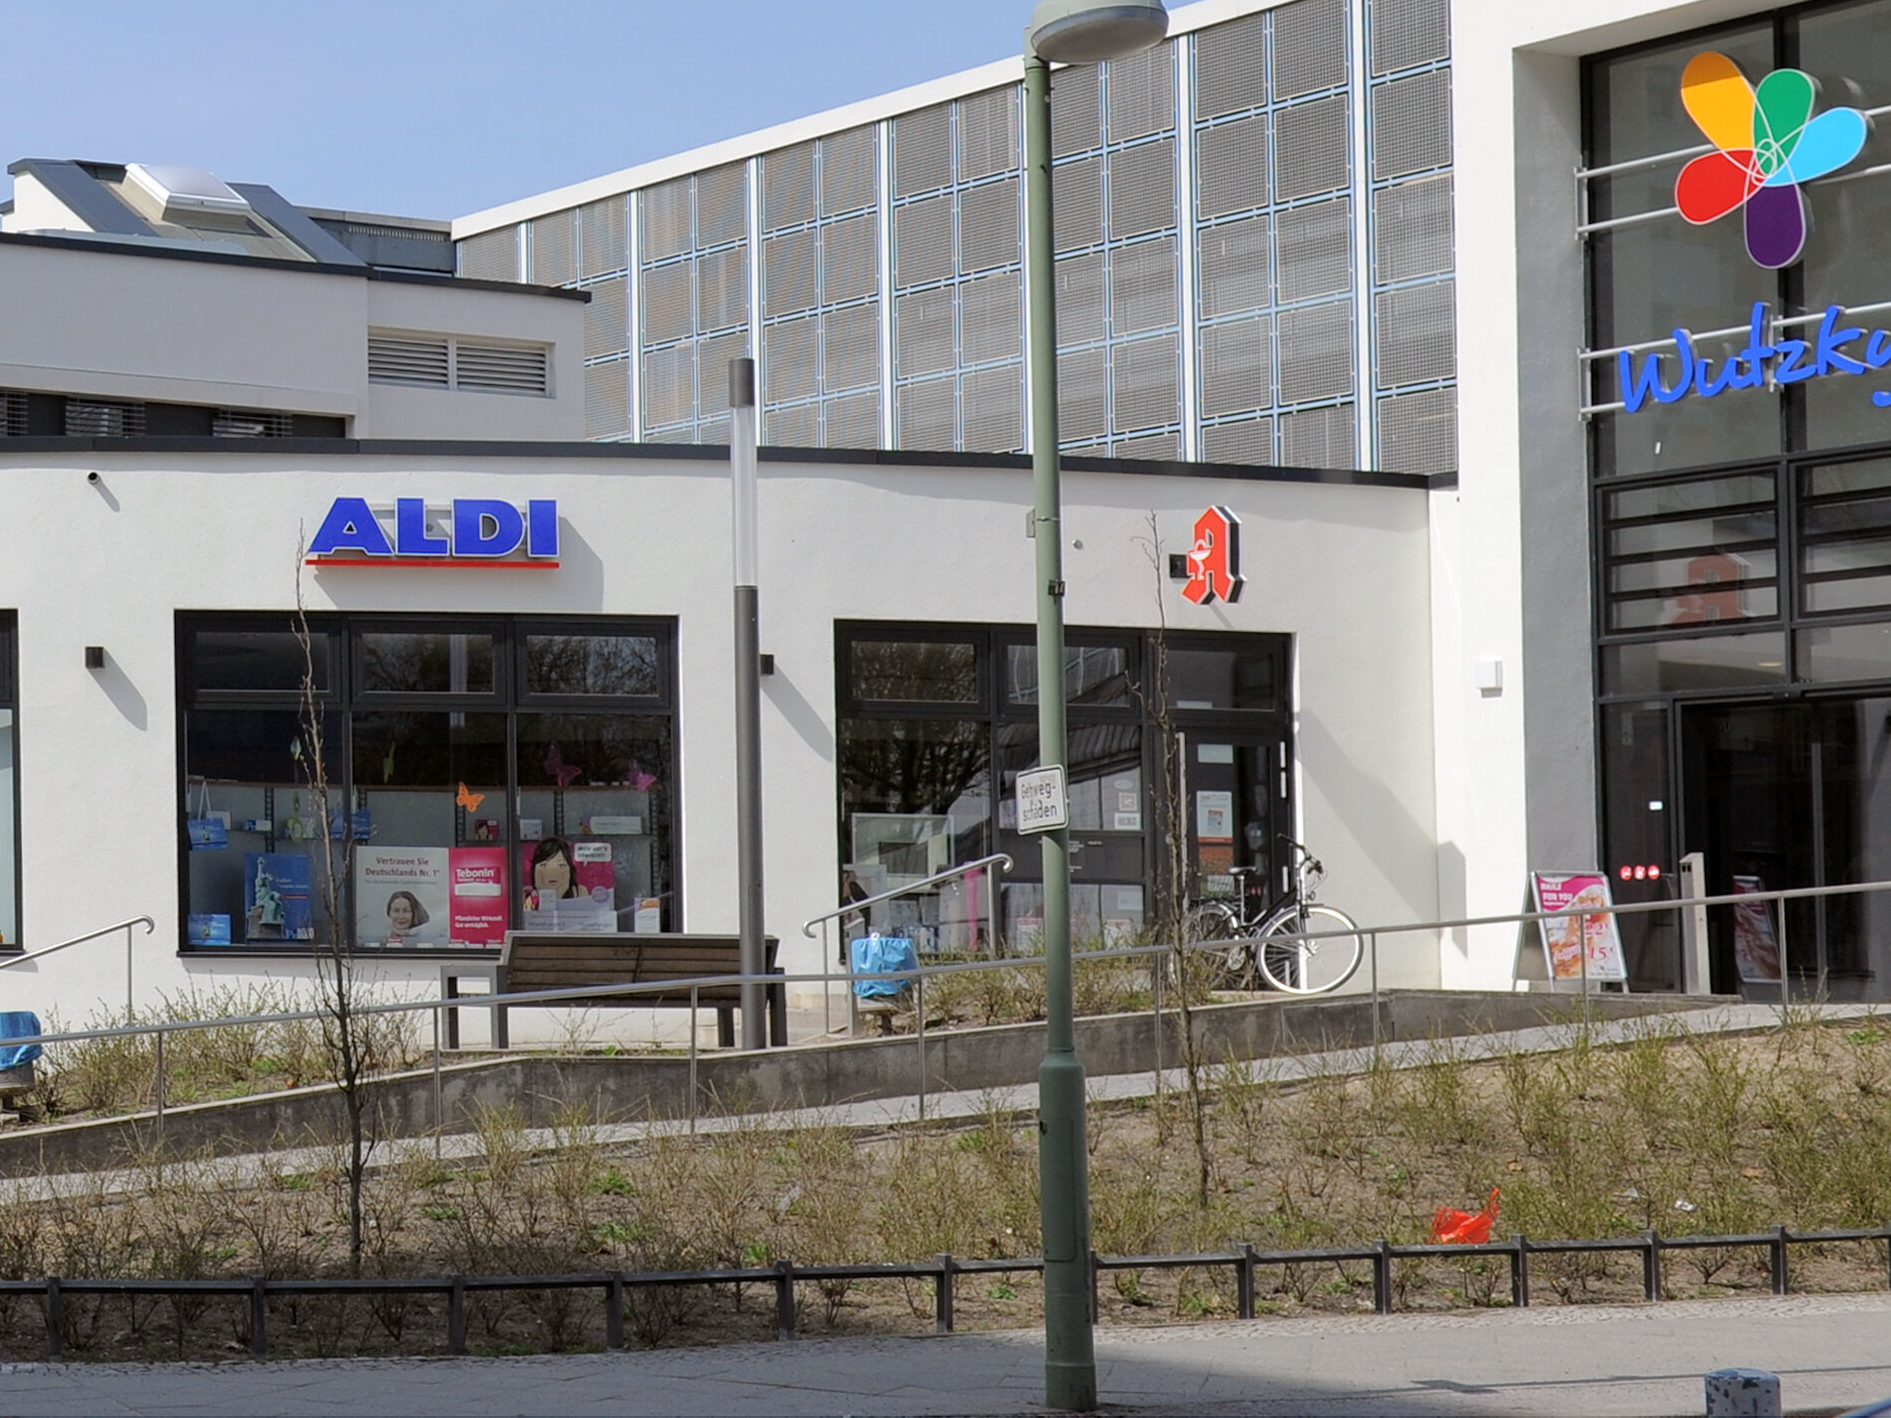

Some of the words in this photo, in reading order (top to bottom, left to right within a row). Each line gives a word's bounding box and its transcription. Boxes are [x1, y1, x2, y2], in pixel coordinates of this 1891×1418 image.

[307, 496, 560, 558] ALDI
[376, 857, 415, 866] Vertrauen
[417, 857, 429, 866] Sie
[365, 868, 418, 877] Deutschlands
